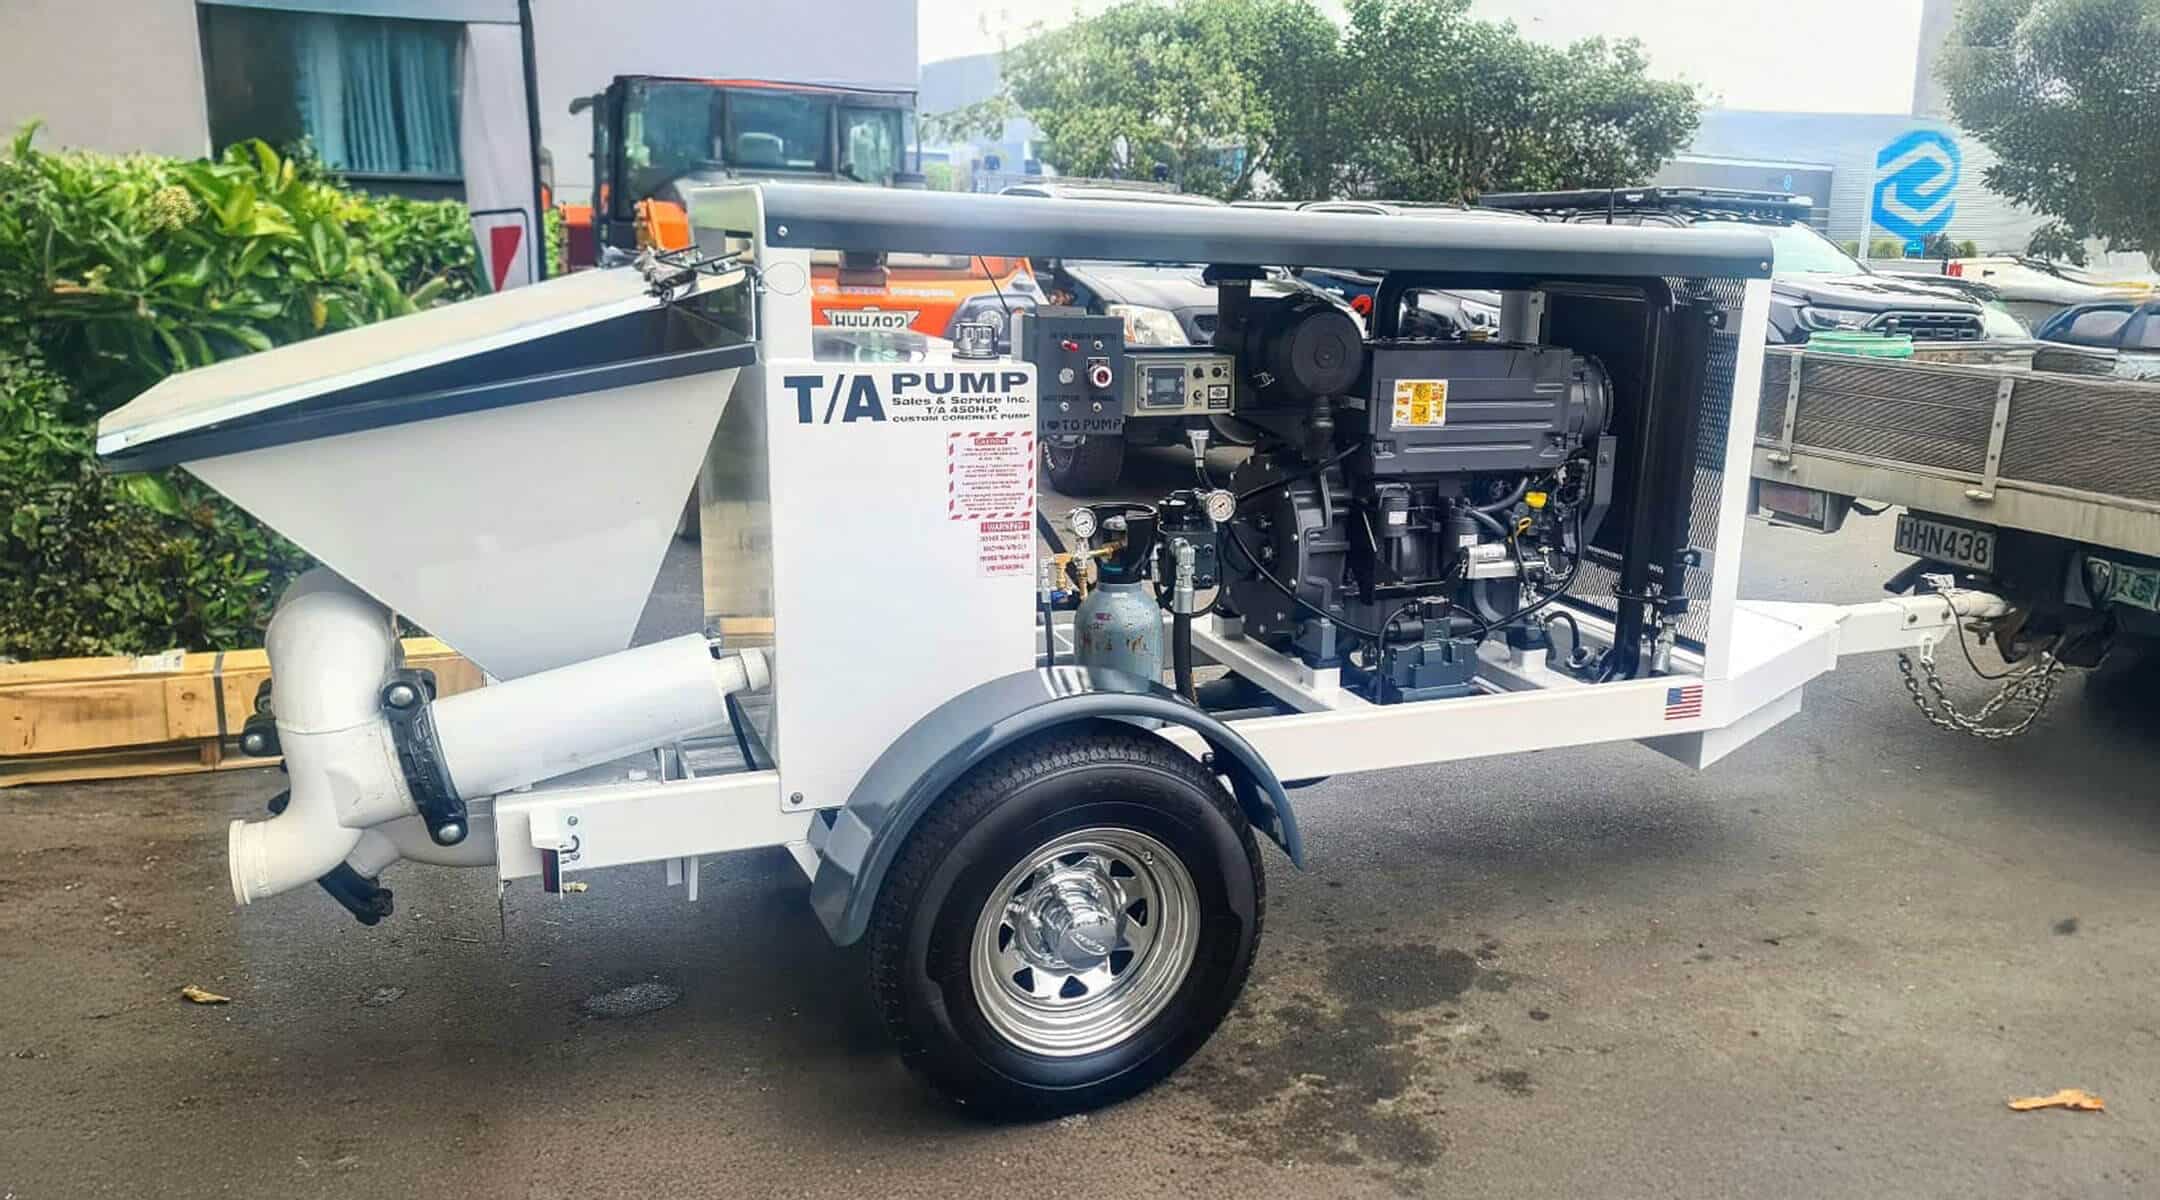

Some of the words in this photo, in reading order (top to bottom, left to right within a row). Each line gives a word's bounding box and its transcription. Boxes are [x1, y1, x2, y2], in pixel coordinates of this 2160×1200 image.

[892, 372, 1029, 394] PUMP
[784, 374, 887, 424] T/A
[892, 396, 931, 406] Sales
[936, 396, 950, 405] &
[951, 395, 1002, 405] Service
[1006, 395, 1030, 404] Inc.
[926, 406, 946, 414] T/A
[892, 415, 938, 423] CUSTOM
[942, 413, 998, 422] CONCRETE
[1062, 419, 1080, 431] TO
[1084, 418, 1123, 431] PUMP
[1900, 516, 1989, 564] HHN438
